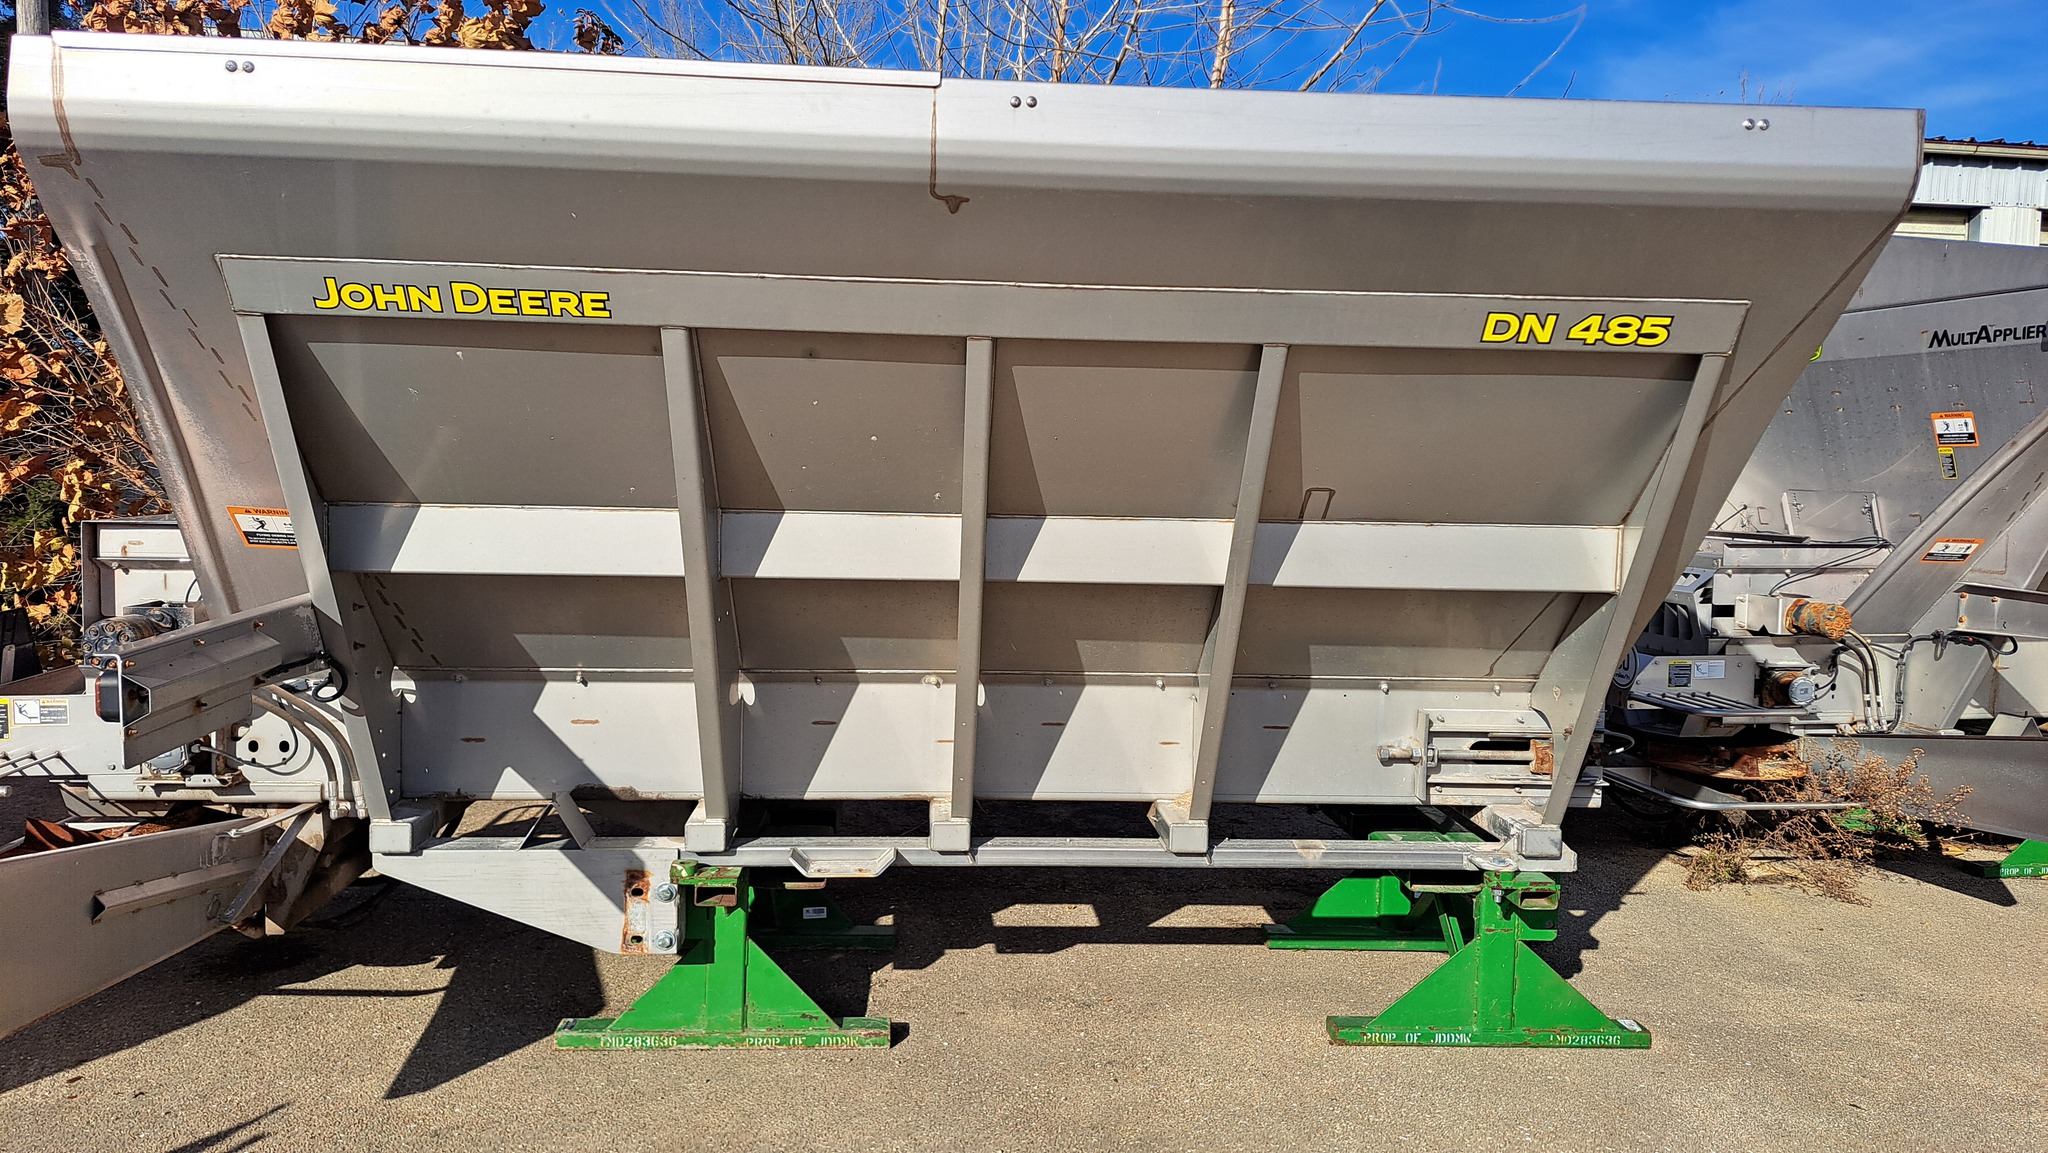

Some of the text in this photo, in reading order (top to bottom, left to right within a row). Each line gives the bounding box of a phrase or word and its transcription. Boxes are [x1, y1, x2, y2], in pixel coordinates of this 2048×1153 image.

[313, 277, 612, 319] JOHN DEERE
[1480, 312, 1675, 347] DN 485
[2000, 867, 2020, 875] PROP
[2023, 867, 2035, 875] OF
[745, 1037, 781, 1047] PROP
[789, 1036, 807, 1047] OF
[1363, 1033, 1397, 1044] PROP
[1405, 1033, 1422, 1044] OF
